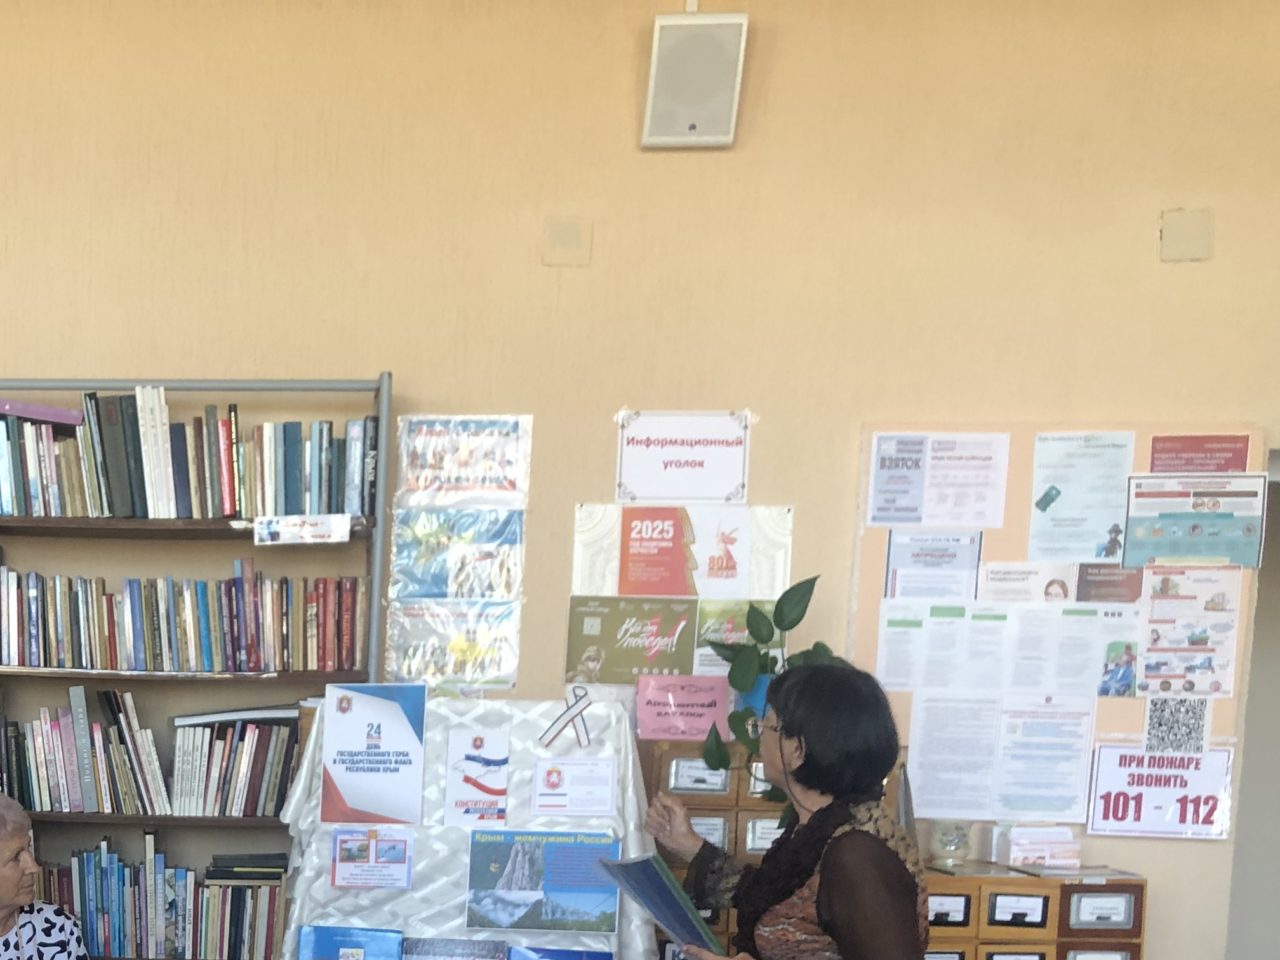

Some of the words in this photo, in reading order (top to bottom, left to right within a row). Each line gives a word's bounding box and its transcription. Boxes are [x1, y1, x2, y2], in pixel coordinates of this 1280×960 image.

[626, 436, 743, 449] Информационный
[662, 459, 705, 470] уголок
[631, 520, 674, 539] 2025
[367, 722, 382, 736] 24
[1119, 754, 1144, 768] ПРИ
[1147, 755, 1202, 770] ПОЖАРЕ
[1127, 773, 1188, 788] ЗВОНИТЬ
[455, 800, 498, 808] КОНСТИТУЦИЯ
[1100, 790, 1143, 822] 101
[1176, 794, 1219, 825] 112
[475, 834, 504, 844] Крым
[514, 836, 574, 844] жемчужина
[577, 835, 613, 844] России
